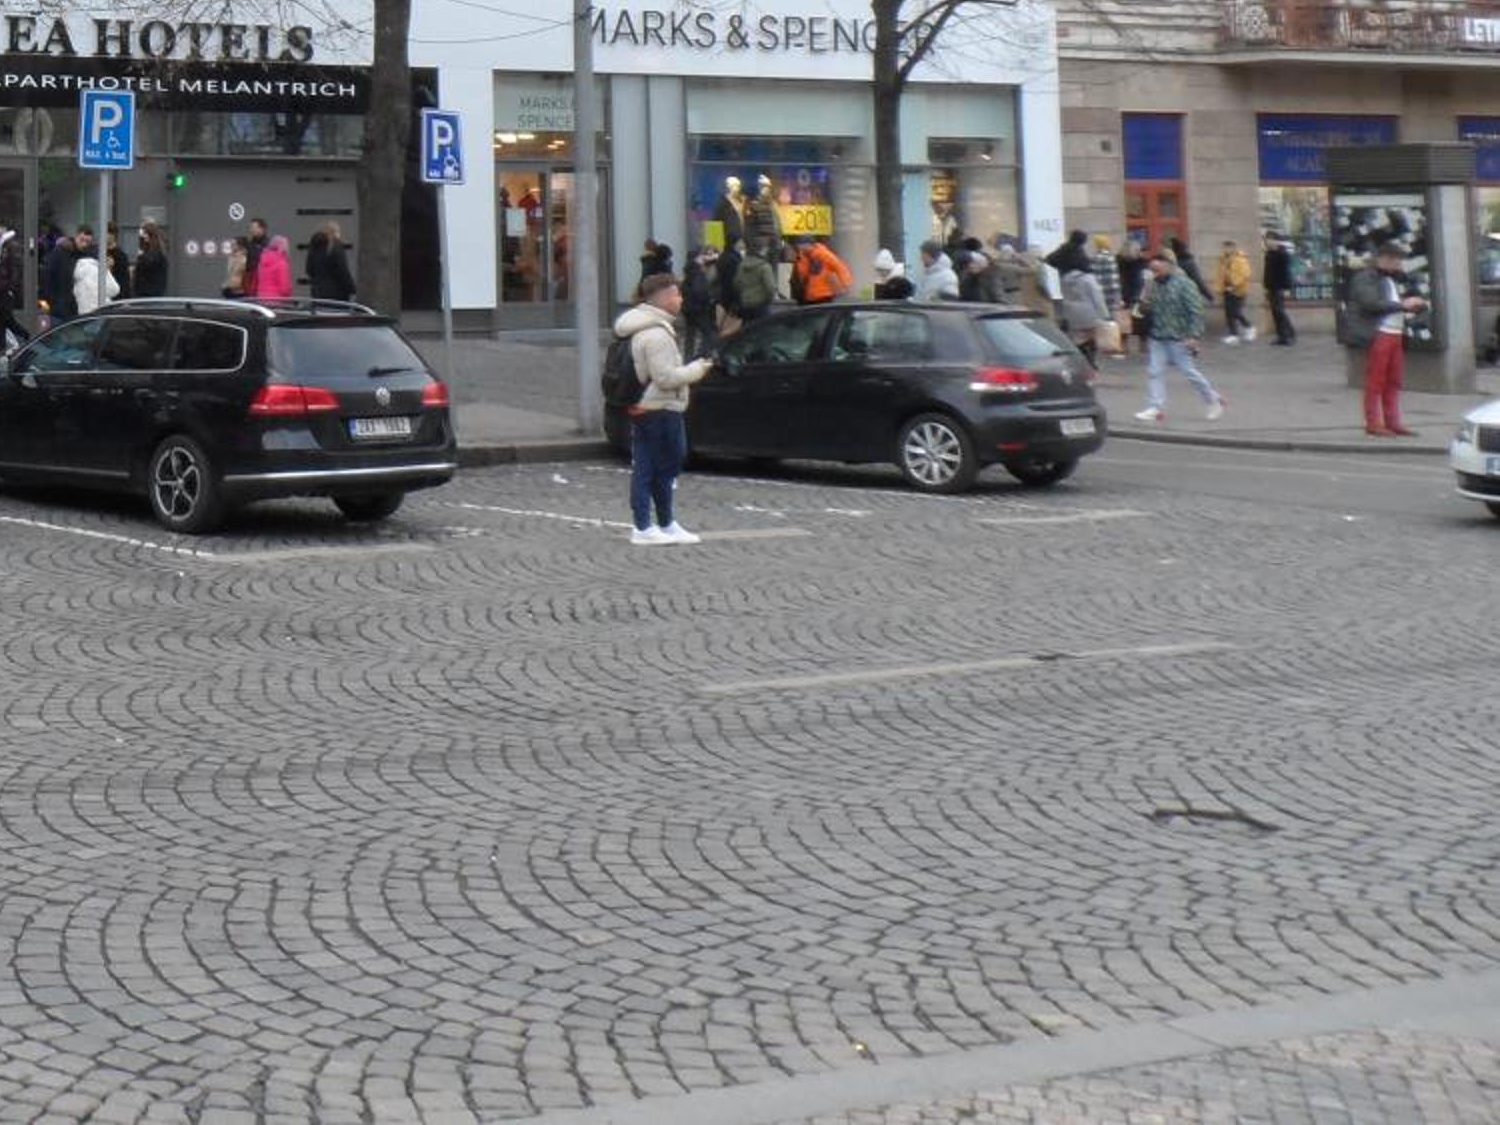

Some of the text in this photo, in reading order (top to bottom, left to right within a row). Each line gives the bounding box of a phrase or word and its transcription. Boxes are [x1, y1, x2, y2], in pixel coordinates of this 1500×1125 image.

[4, 14, 315, 63] EA HOTELS
[727, 14, 749, 49] &
[179, 78, 356, 97] MELANTRICH
[91, 101, 123, 144] P
[431, 119, 453, 160] P
[518, 115, 573, 129] SPENCE
